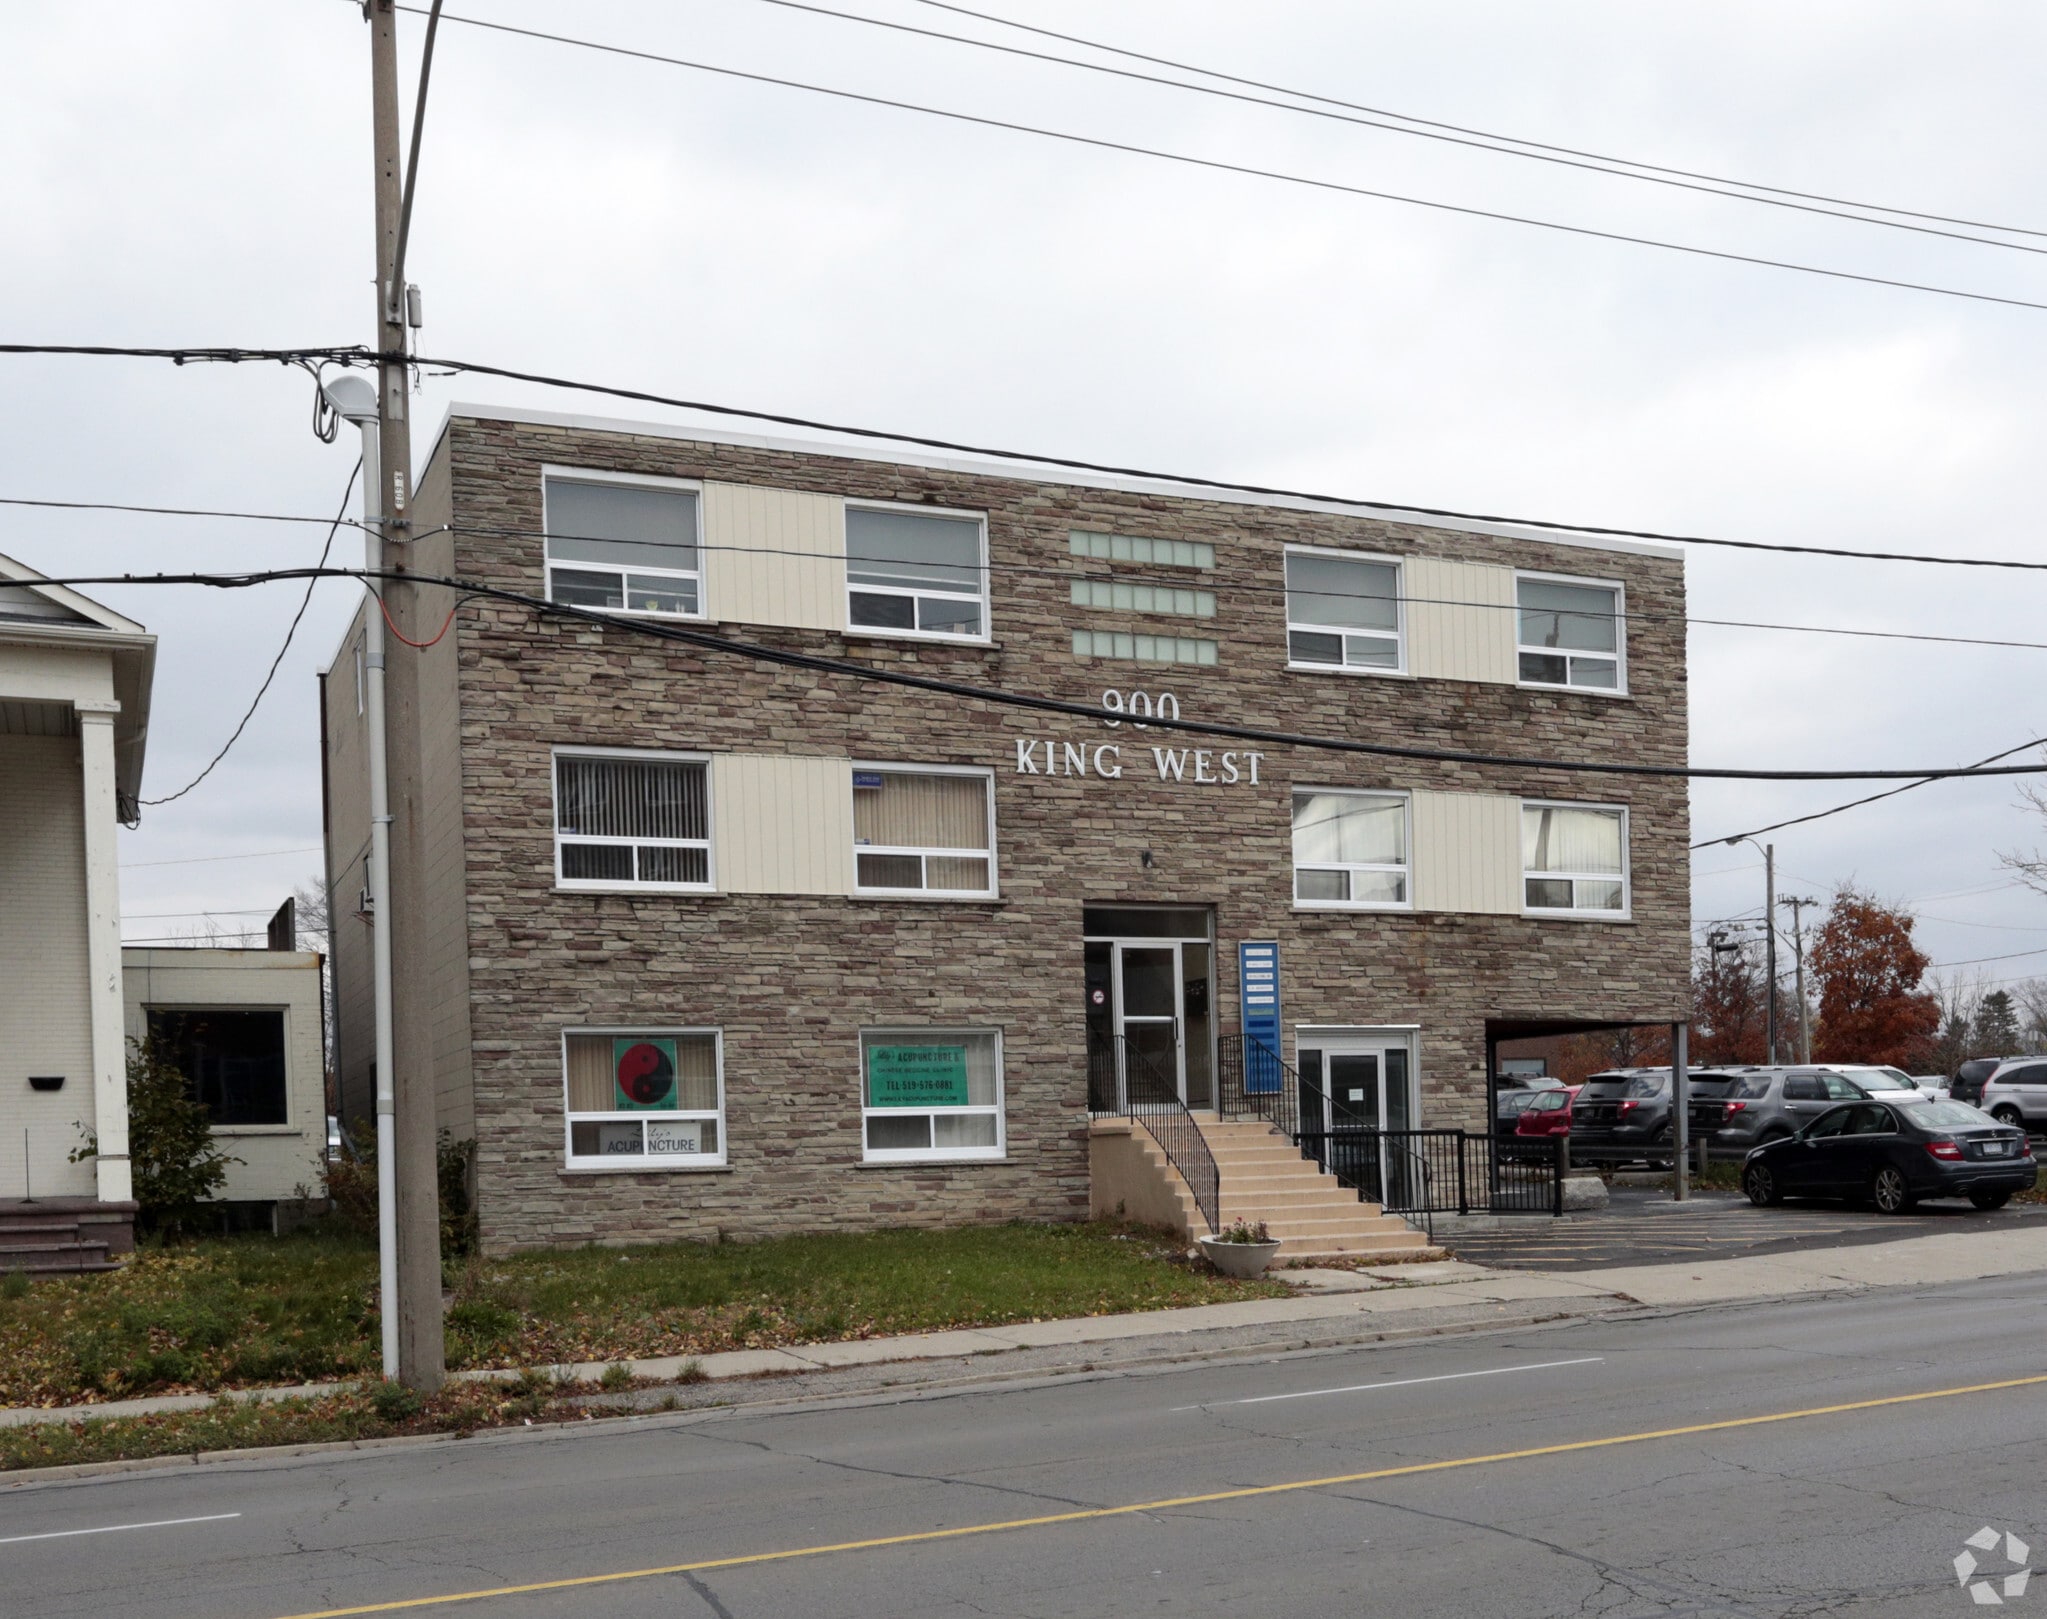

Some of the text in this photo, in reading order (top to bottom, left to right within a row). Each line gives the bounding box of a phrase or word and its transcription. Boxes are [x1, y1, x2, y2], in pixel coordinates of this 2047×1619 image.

[1102, 689, 1180, 731] 900
[1015, 739, 1264, 785] KING WEST
[898, 1052, 952, 1062] ACUPUNCTURE
